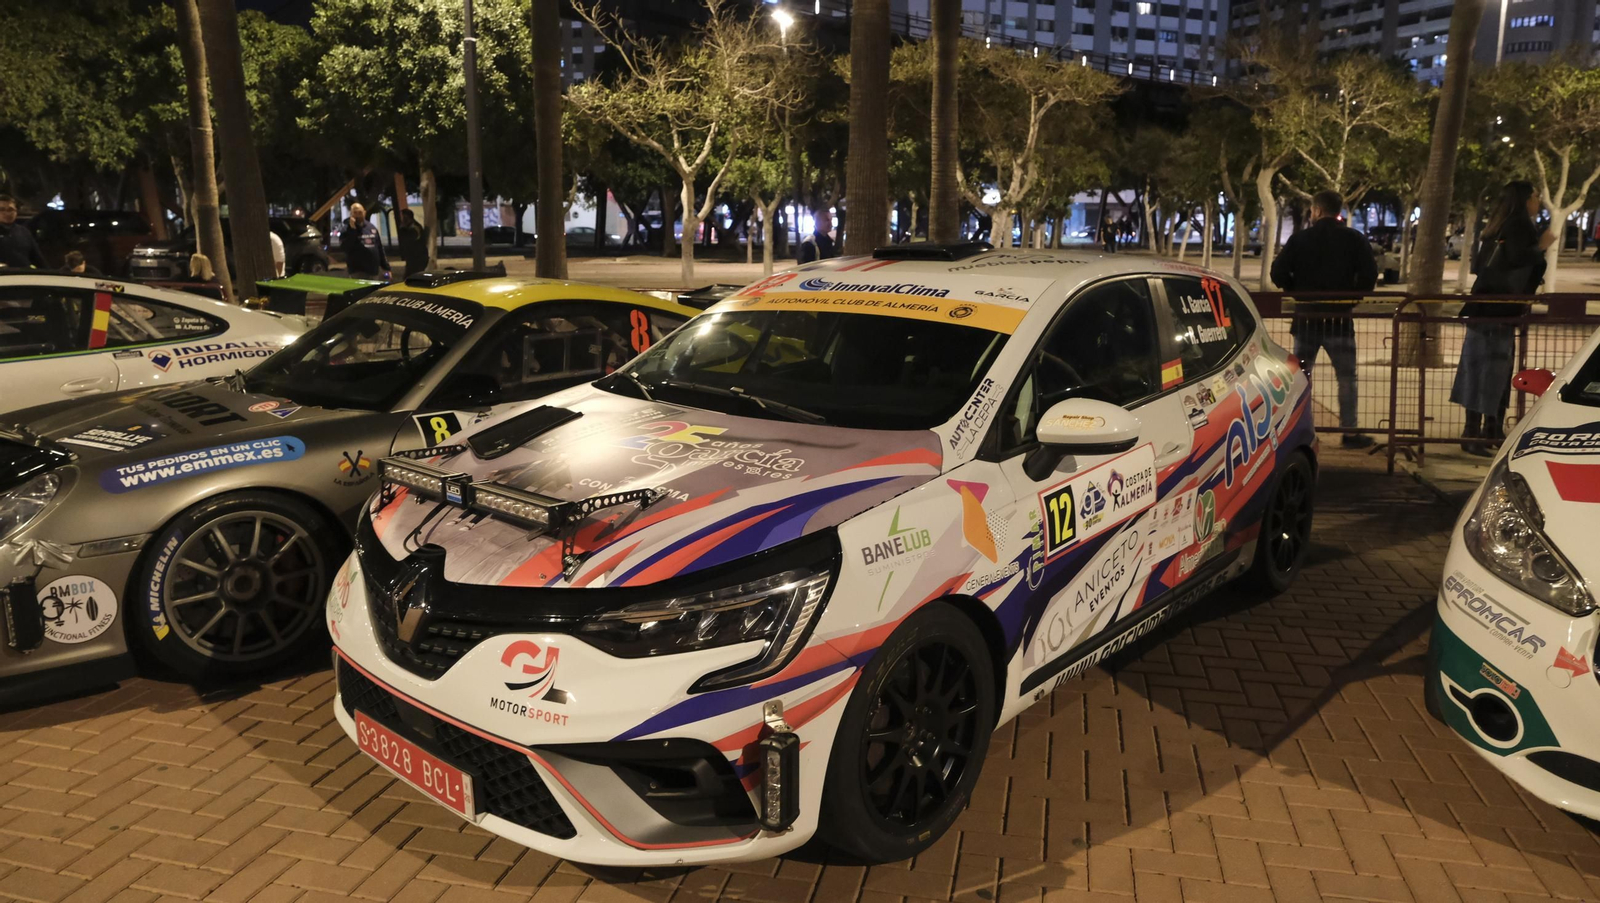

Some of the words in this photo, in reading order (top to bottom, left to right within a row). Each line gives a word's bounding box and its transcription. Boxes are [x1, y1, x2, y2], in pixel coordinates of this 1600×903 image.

[829, 280, 950, 298] InnovalClima
[396, 297, 423, 310] CLUB
[421, 302, 474, 329] ALMERÍA
[768, 296, 830, 305] AUTOMÓVIL
[832, 297, 864, 307] CLUB
[865, 300, 881, 308] DE
[882, 301, 939, 314] ALMERÍA
[630, 309, 650, 354] 8
[1197, 324, 1228, 344] Guerrero
[430, 416, 451, 444] 8
[965, 427, 979, 444] LA
[974, 397, 998, 428] CEPA
[116, 464, 145, 476] TUS
[151, 452, 208, 468] PEDIDOS
[210, 447, 229, 457] EN
[232, 443, 250, 453] UN
[252, 439, 281, 449] CLIC
[711, 438, 765, 449] años
[1529, 439, 1581, 447] COSTA
[119, 447, 284, 488] www.emmex.es
[1125, 472, 1144, 488] COSTA
[1144, 466, 1152, 478] DE
[579, 478, 613, 492] CON
[1120, 479, 1153, 509] ALMERÍA
[1049, 492, 1073, 545] 12
[861, 528, 932, 566] BANELUB
[149, 536, 178, 612] MICHELIN
[867, 549, 936, 577] SUMINISTROS
[1075, 530, 1139, 613] ANICETO
[1089, 564, 1125, 613] EVENTOS
[88, 612, 113, 636] FITNESS
[1444, 575, 1547, 654] EPROMCAR
[490, 697, 569, 726] MOTORSPORT
[422, 759, 456, 803] BCL
